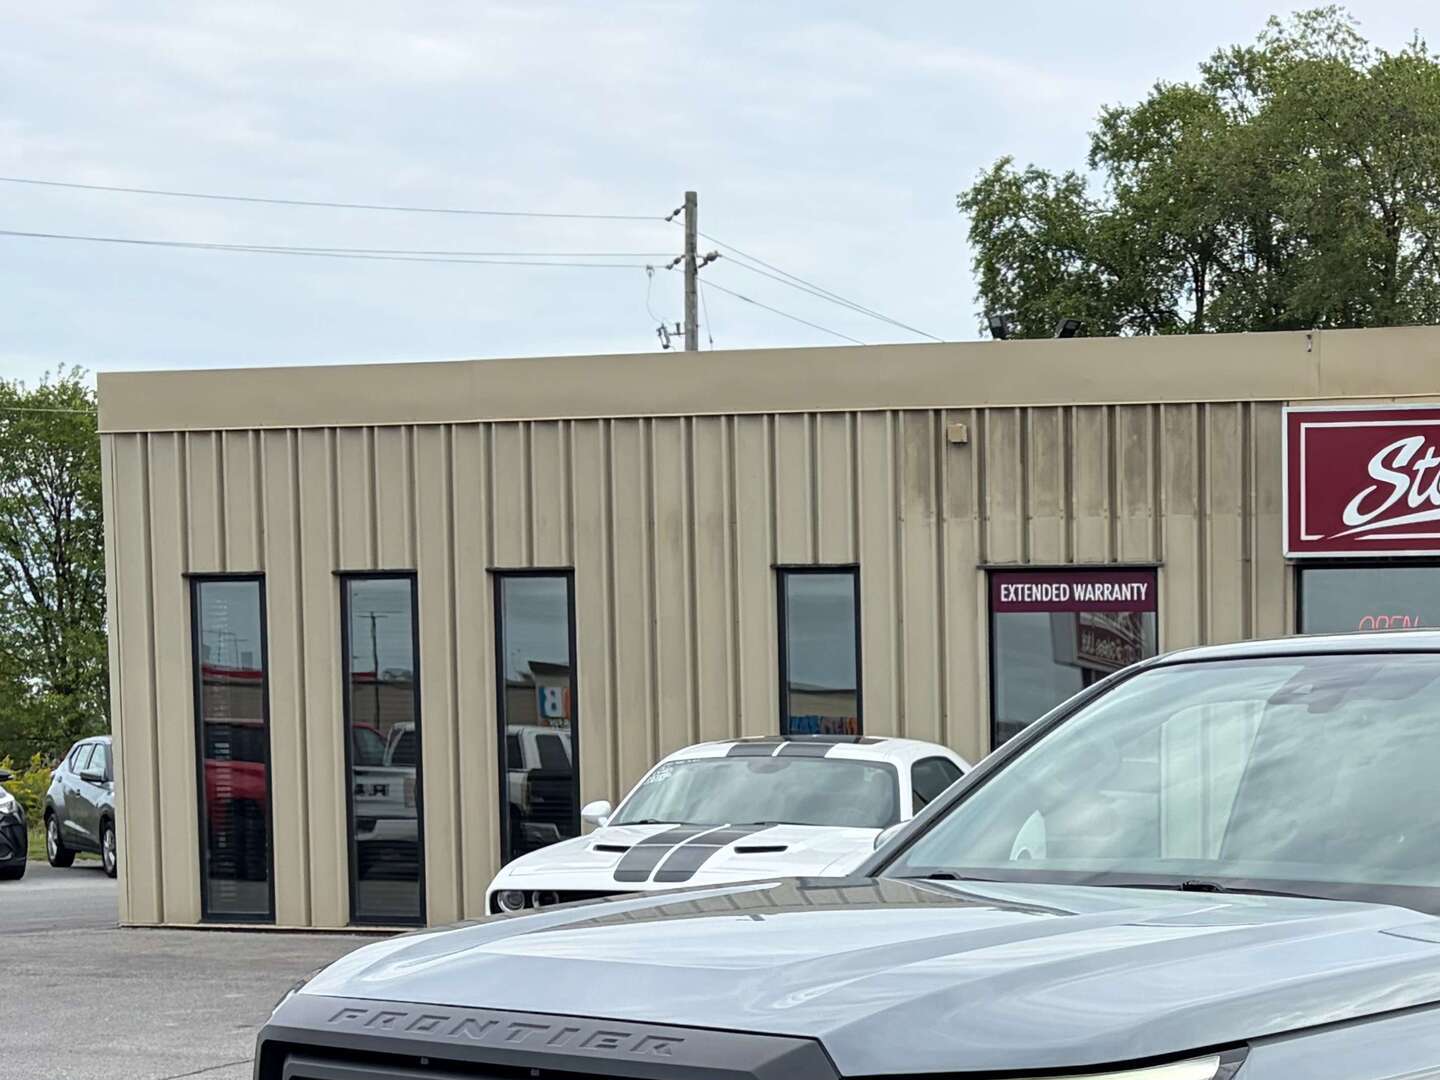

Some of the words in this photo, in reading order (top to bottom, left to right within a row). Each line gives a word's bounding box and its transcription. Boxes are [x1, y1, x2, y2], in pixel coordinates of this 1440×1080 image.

[1000, 583, 1070, 602] EXTENDED
[1073, 583, 1148, 602] WARRANTY
[327, 1007, 685, 1057] FRONTIER
